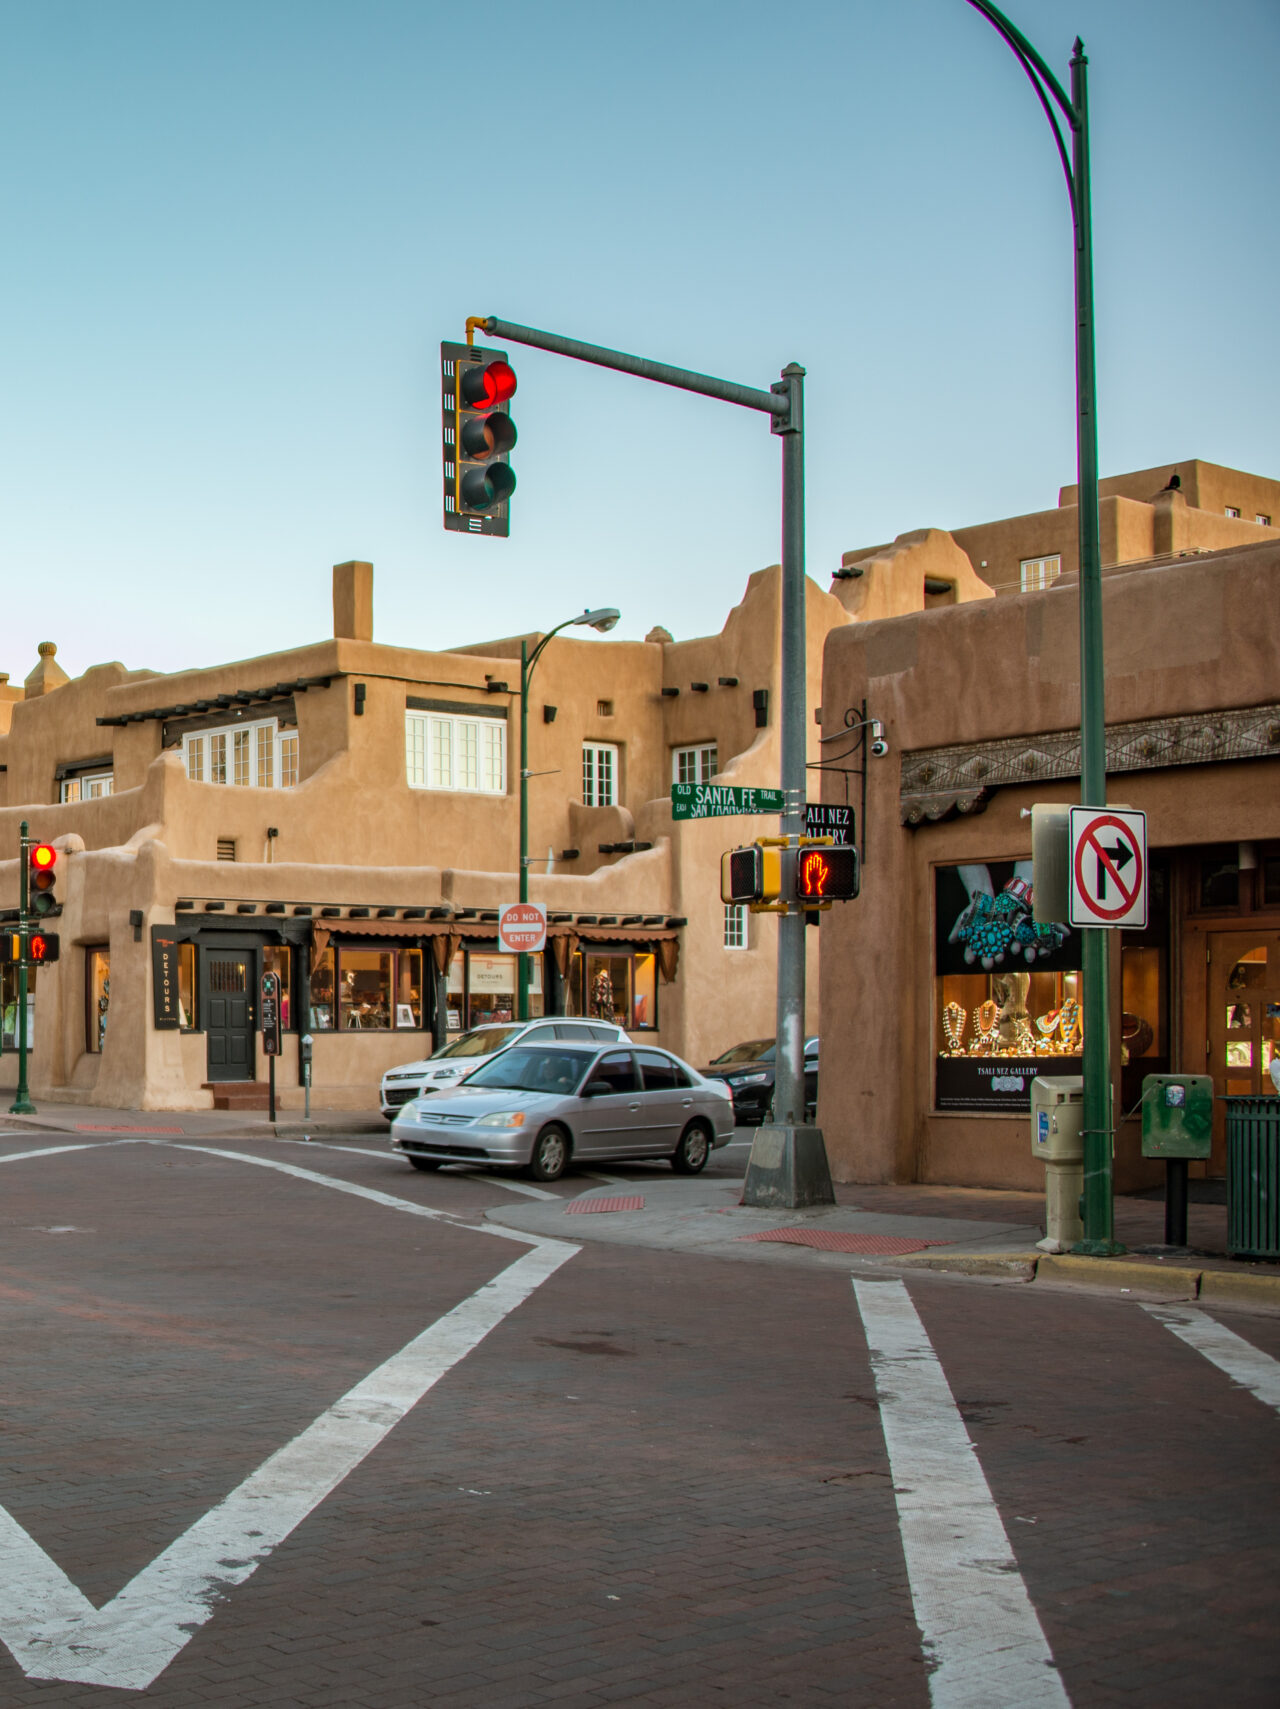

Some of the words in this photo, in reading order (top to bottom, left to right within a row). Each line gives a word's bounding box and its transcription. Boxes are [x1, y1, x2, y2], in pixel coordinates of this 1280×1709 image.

[677, 784, 691, 795] OLD
[696, 786, 736, 805] SANTA
[741, 788, 756, 807] FE
[760, 789, 778, 801] TRAIL
[691, 803, 708, 818] SAN
[807, 807, 825, 824] ALI
[828, 808, 850, 825] NEZ
[506, 913, 518, 921] DO
[522, 912, 540, 921] NOT
[510, 934, 536, 942] ENTER
[162, 953, 170, 1012] DETOURS
[977, 1067, 996, 1076] TSALI
[997, 1067, 1009, 1076] NEZ
[1010, 1067, 1038, 1076] GALLERY
